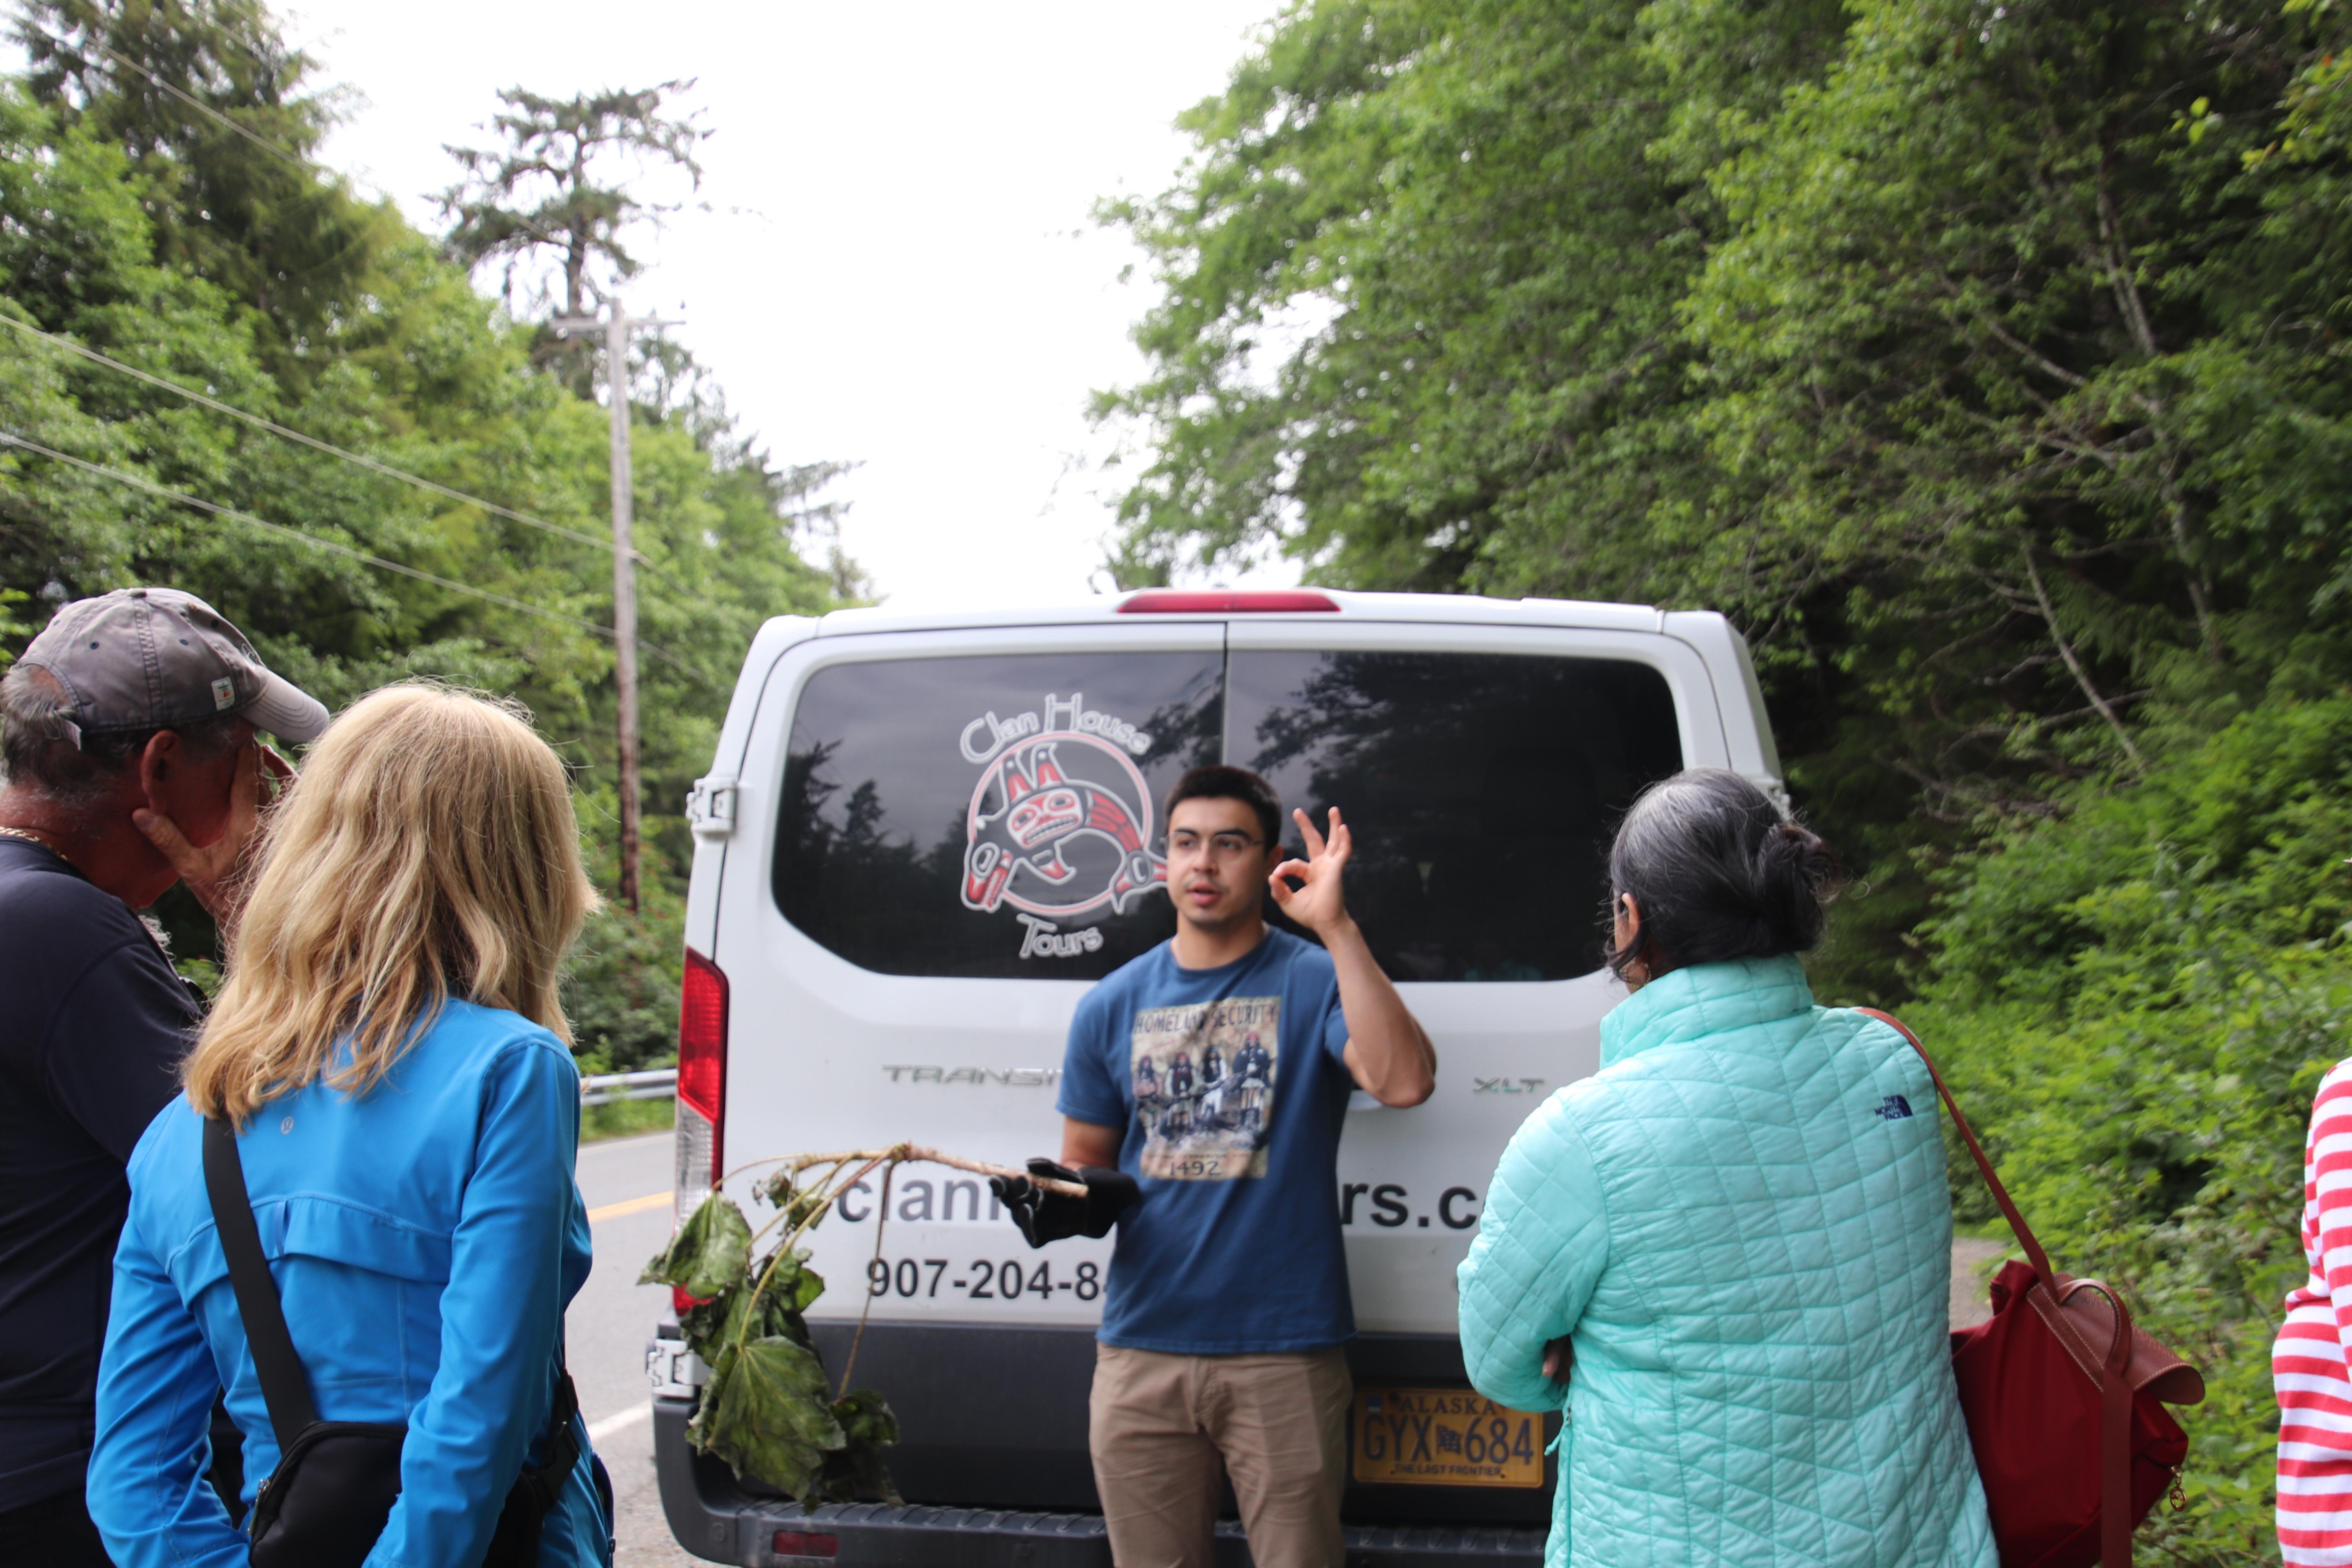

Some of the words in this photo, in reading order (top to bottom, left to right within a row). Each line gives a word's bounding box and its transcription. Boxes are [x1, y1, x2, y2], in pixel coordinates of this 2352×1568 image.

[960, 710, 1041, 764] Clan
[1042, 692, 1151, 755] House
[1016, 913, 1104, 959] Tours
[1211, 1004, 1276, 1029] SECURITY
[1472, 1076, 1544, 1093] XLT
[1170, 1161, 1220, 1176] 1492
[867, 1258, 1106, 1301] 907-204-8
[1401, 1397, 1497, 1414] ALASKA
[1364, 1415, 1433, 1461] GYX
[1465, 1417, 1533, 1465] 684
[1394, 1463, 1415, 1474] THE
[1418, 1464, 1445, 1475] LAST
[1450, 1465, 1501, 1476] FRONTIER
